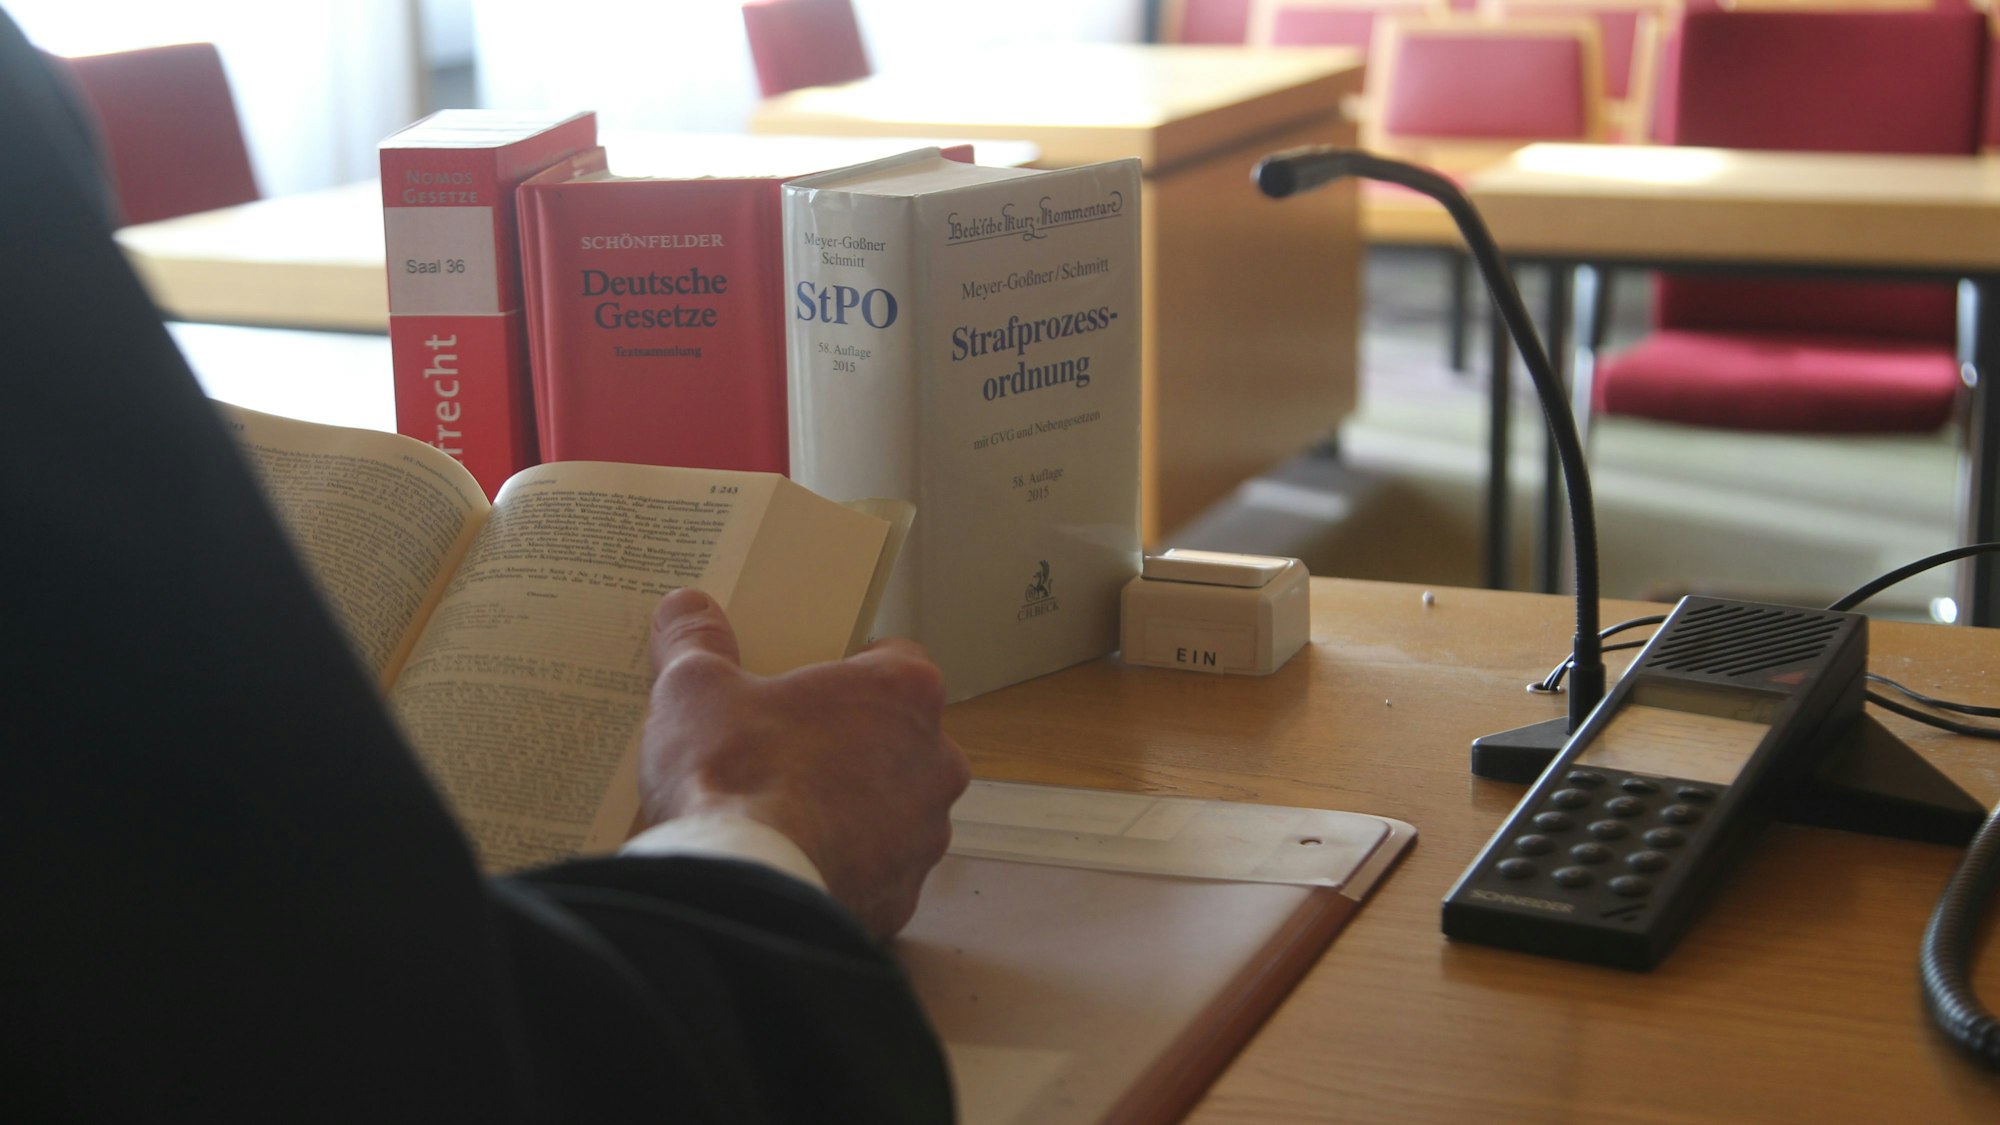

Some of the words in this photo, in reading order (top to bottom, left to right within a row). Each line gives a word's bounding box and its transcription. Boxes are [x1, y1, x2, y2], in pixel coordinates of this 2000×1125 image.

[580, 233, 724, 250] SCHÖNFELDER
[804, 232, 886, 252] Meyer-Goßner
[406, 259, 441, 274] Saal
[446, 260, 466, 274] 36
[822, 252, 865, 268] Schmitt
[581, 268, 727, 296] Deutsche
[796, 280, 898, 329] StPO
[594, 302, 718, 329] Gesetze
[951, 305, 1118, 362] Strafprozess-
[613, 346, 702, 358] Textsammlung
[818, 342, 832, 354] 58.
[834, 345, 872, 359] Auflage
[833, 359, 856, 373] 2015
[983, 355, 1091, 401] ordnung
[424, 334, 463, 463] frecht
[974, 436, 989, 449] mit
[991, 429, 1015, 445] GVG
[1017, 425, 1033, 438] und
[1035, 411, 1100, 434] Nebengesetzen
[1029, 468, 1063, 484] Auflage
[719, 486, 738, 494] 243
[1027, 486, 1049, 502] 2015
[1176, 647, 1216, 666] EIN
[1470, 889, 1575, 912] SCHNEIDER
